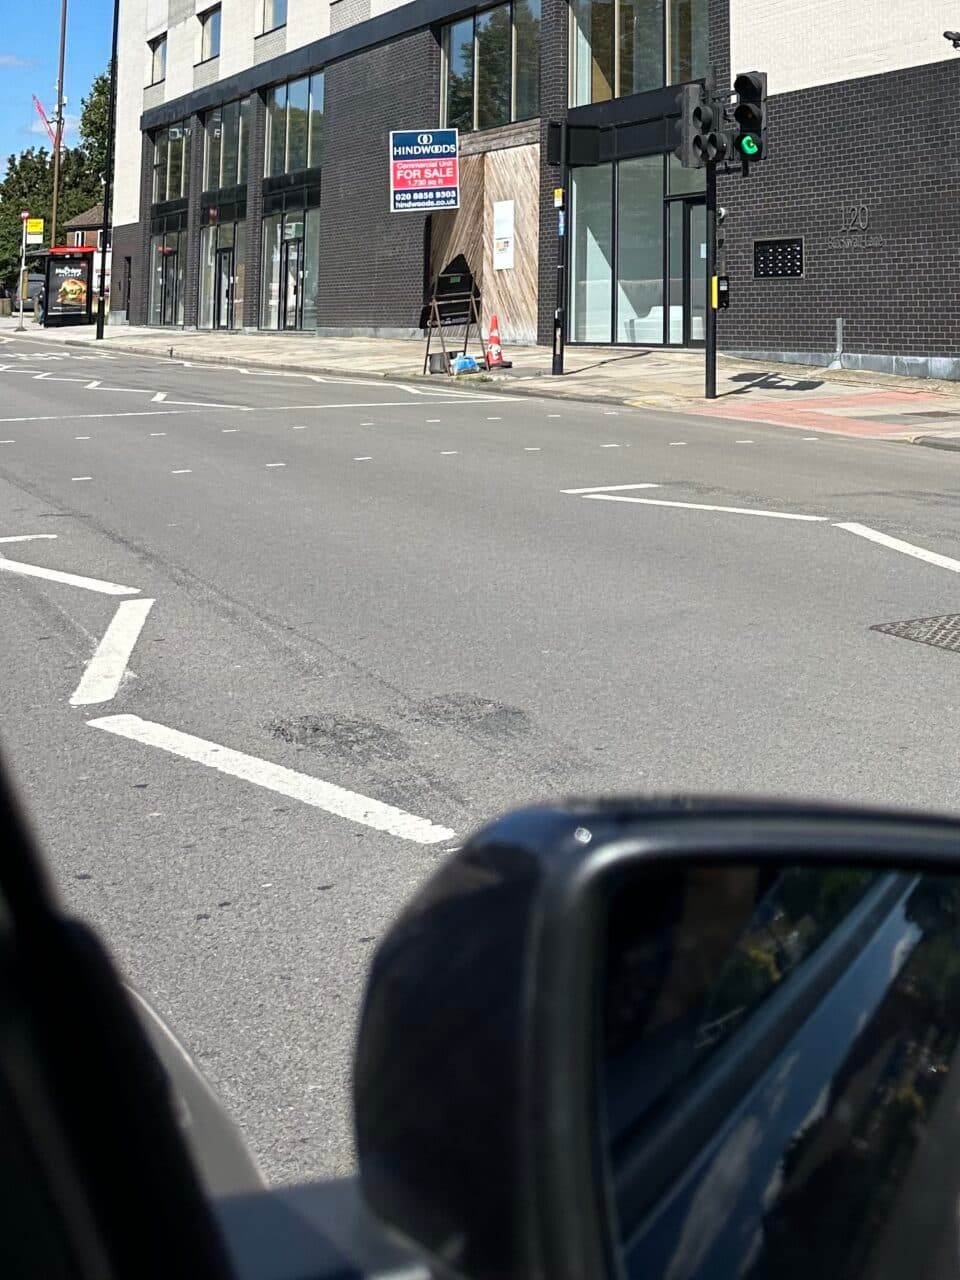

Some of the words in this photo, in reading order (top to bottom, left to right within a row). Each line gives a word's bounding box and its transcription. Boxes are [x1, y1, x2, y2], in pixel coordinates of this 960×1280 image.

[394, 144, 456, 155] HINDWOODS
[439, 160, 453, 168] Unit
[396, 170, 421, 180] FOR
[424, 168, 453, 178] SALE
[395, 199, 456, 208] hindwoods.co.uk
[839, 206, 869, 231] 120
